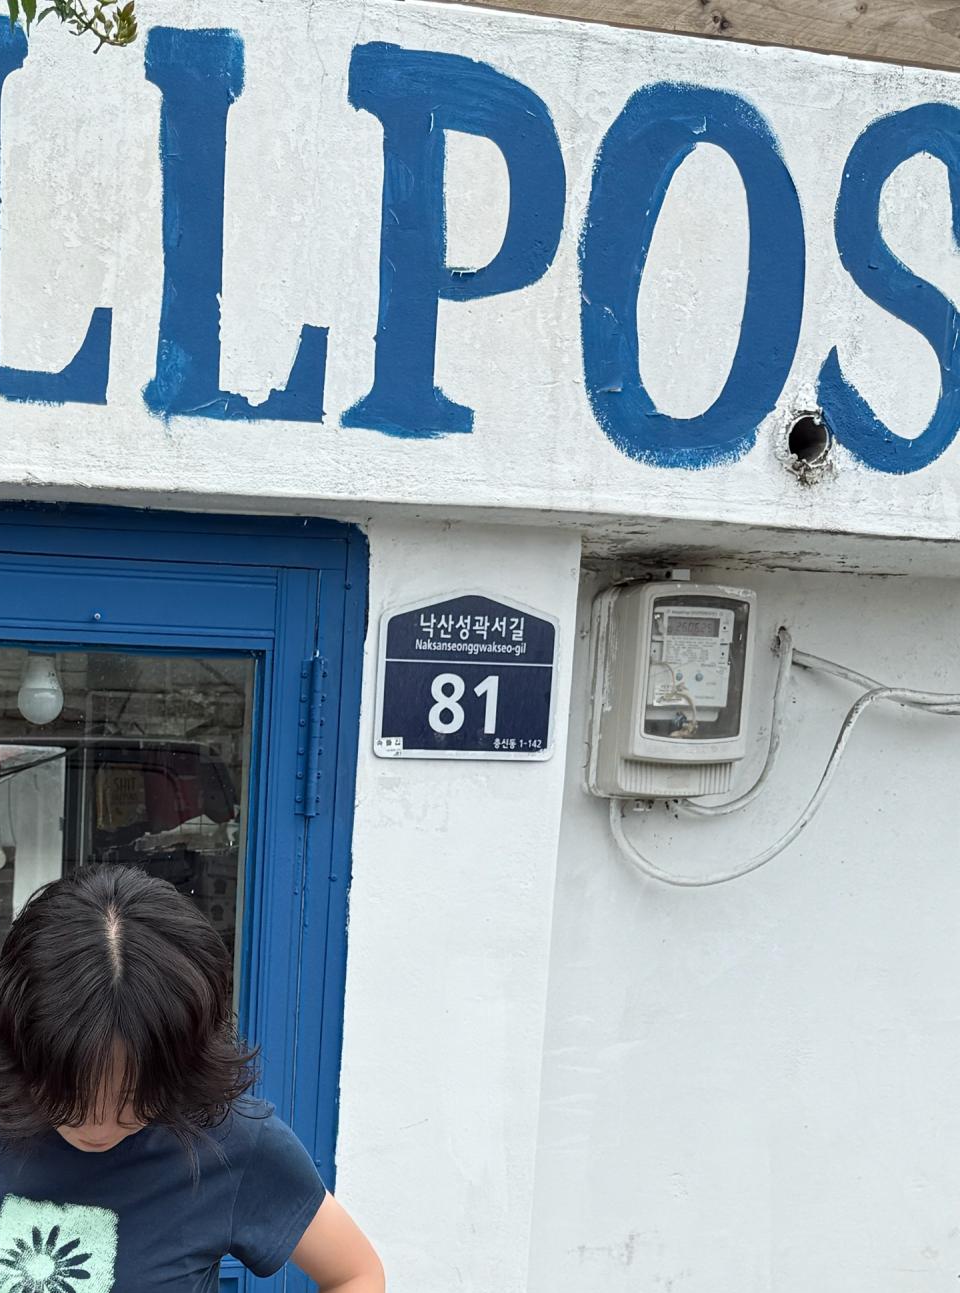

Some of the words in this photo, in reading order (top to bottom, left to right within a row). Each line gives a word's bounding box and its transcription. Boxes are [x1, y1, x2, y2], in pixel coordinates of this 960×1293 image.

[419, 613, 525, 642] 낙산성곽서길
[415, 639, 527, 657] Naksanseonggwakseo-gil
[428, 672, 500, 735] 81
[519, 739, 543, 749] 1-142
